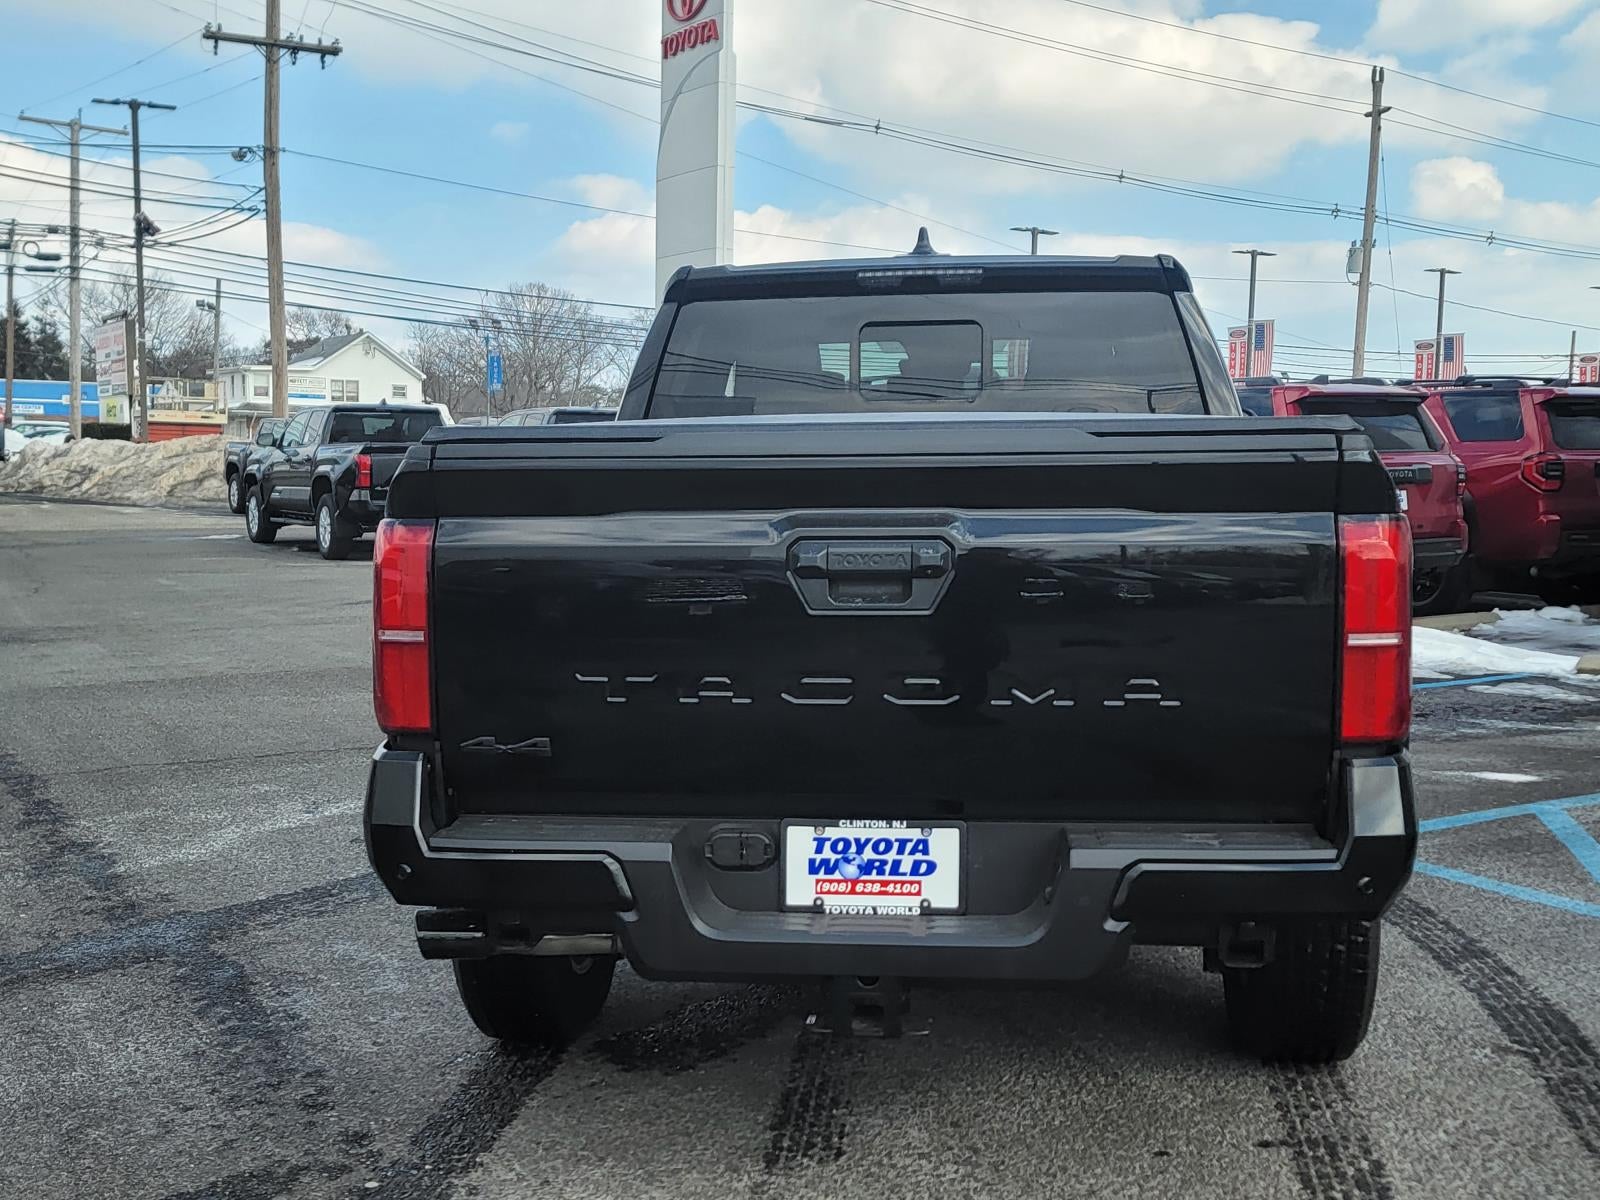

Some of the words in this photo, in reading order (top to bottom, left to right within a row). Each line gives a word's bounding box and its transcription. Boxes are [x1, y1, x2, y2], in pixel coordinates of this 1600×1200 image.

[661, 18, 720, 60] TOYOTA
[1389, 470, 1413, 478] OYOTA
[831, 553, 908, 568] TOYOTA
[575, 673, 1181, 706] TACOMA
[892, 819, 907, 829] NJ
[812, 836, 931, 857] TOYOTA
[808, 854, 938, 880] WORLD
[816, 882, 852, 894] (908)
[855, 882, 920, 895] 638-4100
[823, 905, 875, 916] TOYOTA
[877, 905, 921, 916] WORLD
